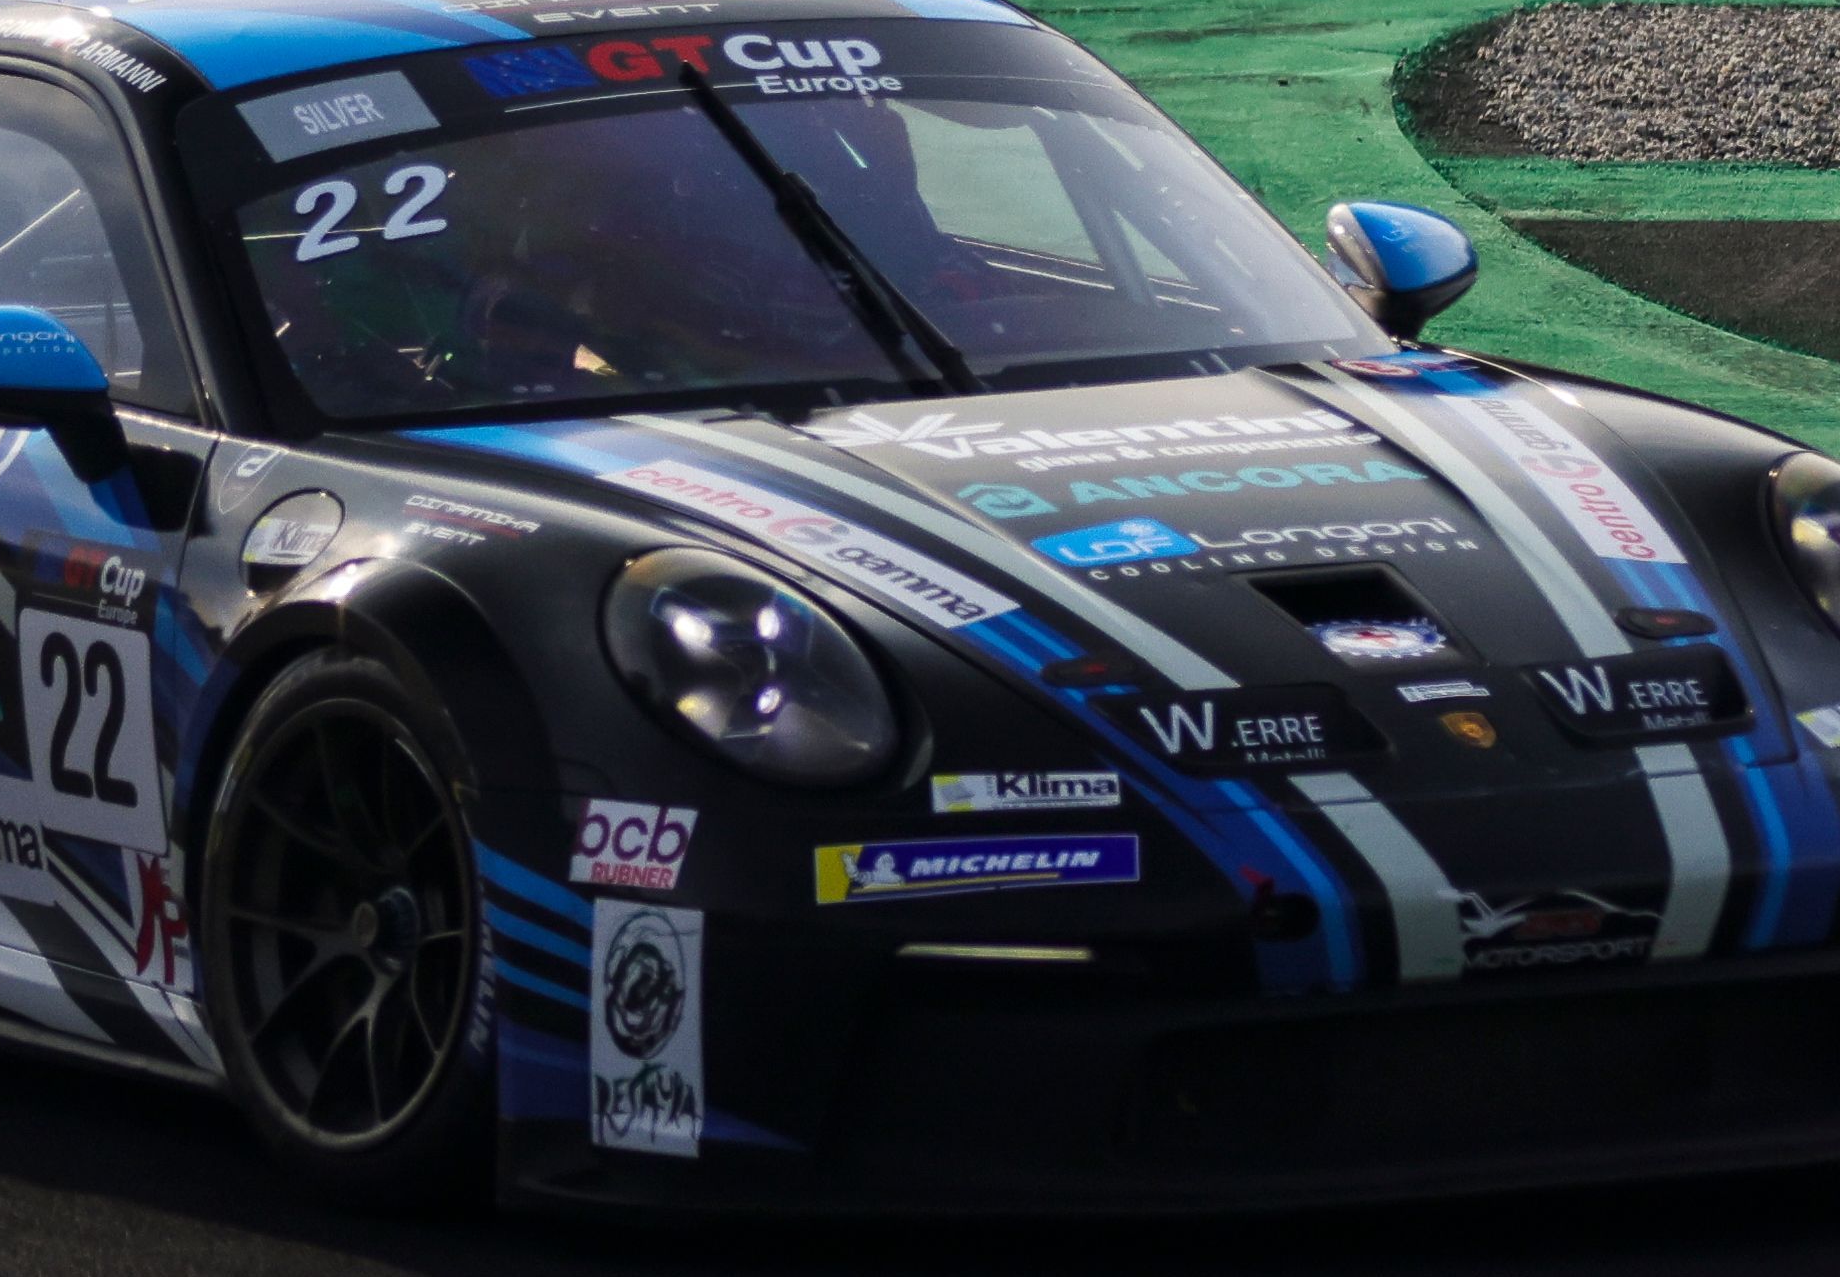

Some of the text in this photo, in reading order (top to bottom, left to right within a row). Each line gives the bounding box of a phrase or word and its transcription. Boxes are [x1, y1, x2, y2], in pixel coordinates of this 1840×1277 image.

[533, 3, 720, 25] EVENT
[585, 33, 884, 83] GT Cup
[756, 73, 904, 97] Europe
[292, 90, 386, 136] SILVER
[294, 163, 451, 263] 22
[2, 344, 76, 357] DESIGN
[905, 409, 1356, 461] Valentini
[1471, 398, 1574, 452] gamma
[1015, 431, 1382, 474] glass & components
[1069, 459, 1430, 506] ANCORA
[403, 521, 487, 546] EVENT
[404, 493, 541, 535] DINAMIKA
[1189, 516, 1458, 549] Longoni
[1570, 482, 1657, 560] centro
[624, 464, 776, 524] centro
[823, 539, 987, 624] gamma
[1090, 538, 1481, 582] COOLING DESIGN
[99, 554, 144, 604] Cup
[97, 598, 139, 626] Europe
[1539, 664, 1617, 716] W
[38, 632, 139, 809] 22
[1140, 699, 1215, 755] W
[995, 771, 1120, 801] Klima
[575, 802, 688, 865] bcb
[590, 862, 675, 889] RUBNER
[909, 848, 1102, 878] MICHELIN
[1466, 939, 1650, 968] MOTORSPORT
